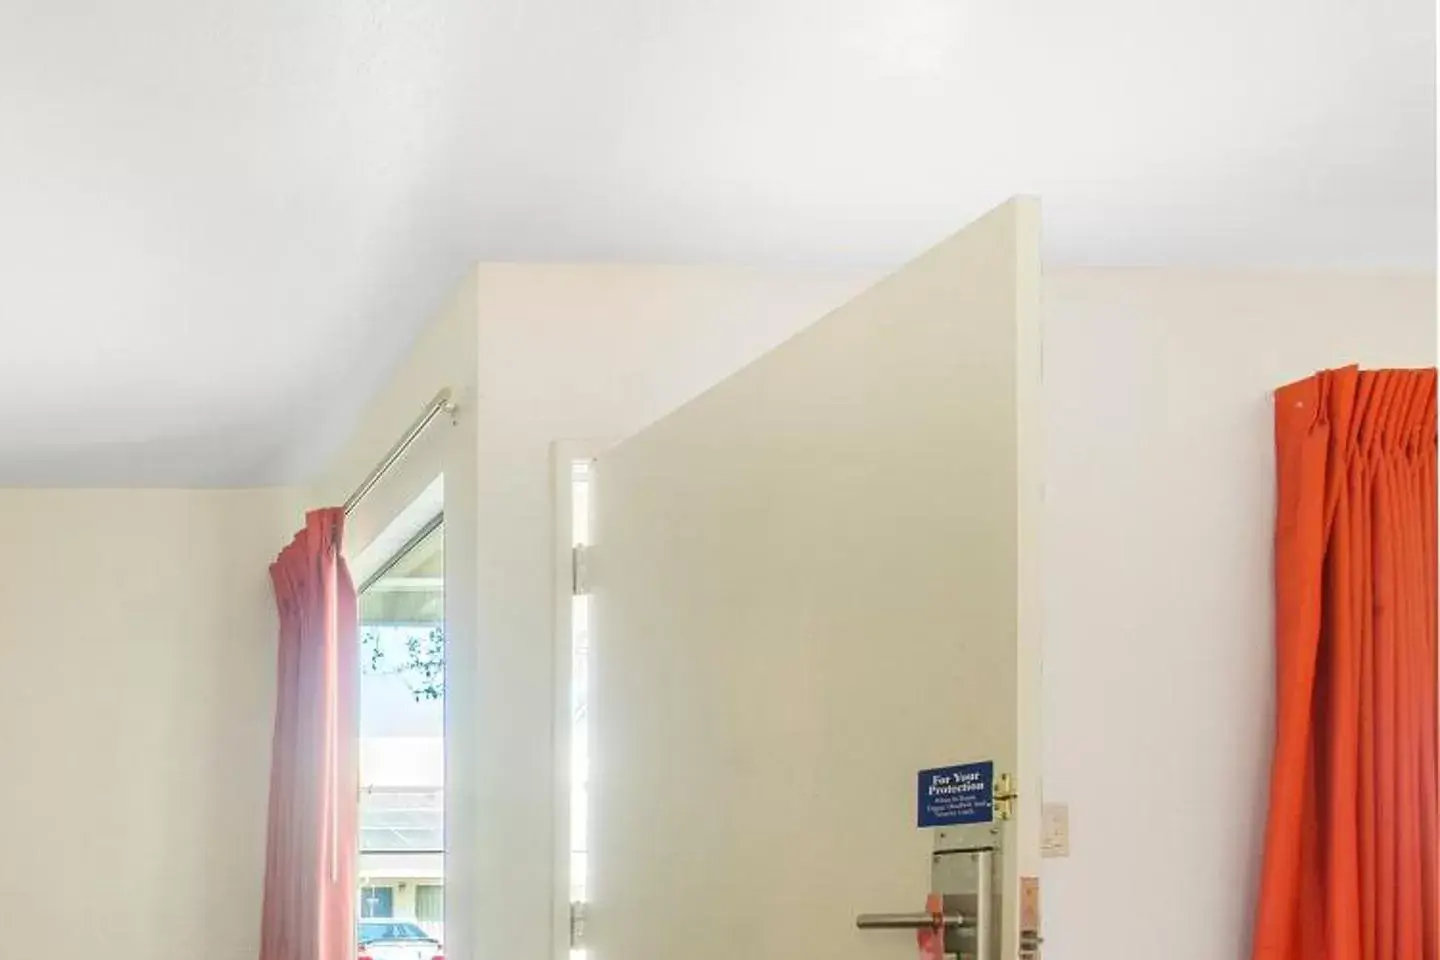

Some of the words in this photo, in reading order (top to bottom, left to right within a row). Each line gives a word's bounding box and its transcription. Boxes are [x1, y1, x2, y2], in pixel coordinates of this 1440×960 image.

[932, 775, 950, 785] For
[953, 772, 980, 782] Your
[928, 781, 984, 795] Protection
